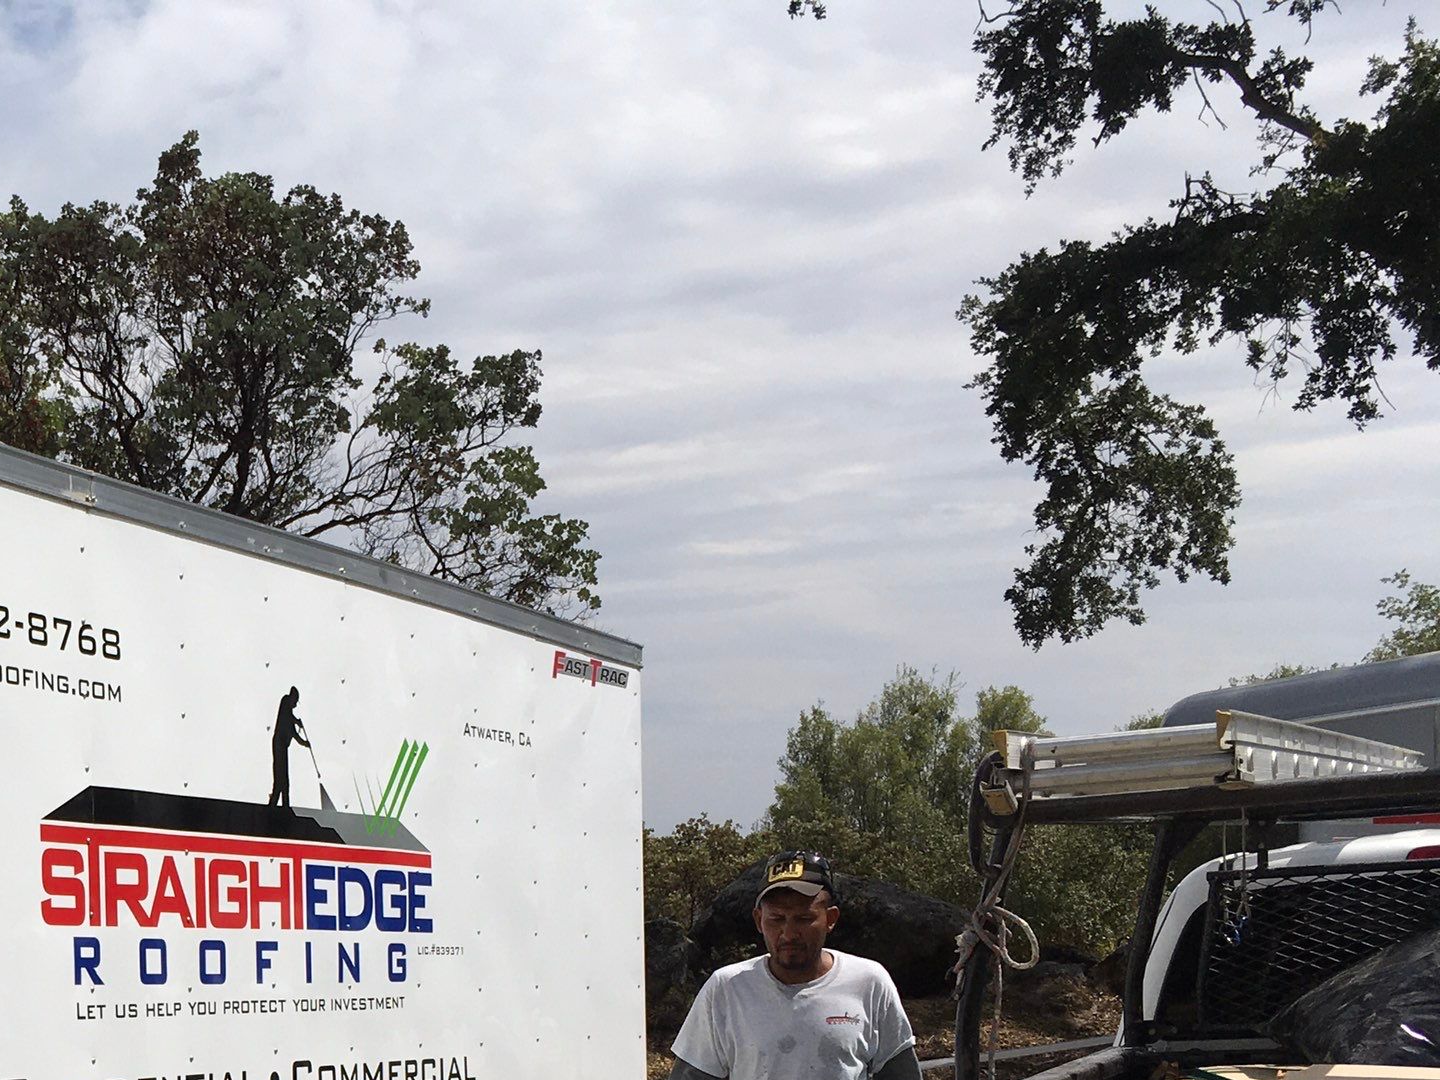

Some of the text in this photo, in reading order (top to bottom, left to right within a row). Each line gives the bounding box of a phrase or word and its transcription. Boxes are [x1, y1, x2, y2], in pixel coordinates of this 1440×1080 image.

[73, 936, 407, 986] ROOFING
[76, 996, 405, 1020] LET US HELP YOU PROTECT YOUR INVESTMENT
